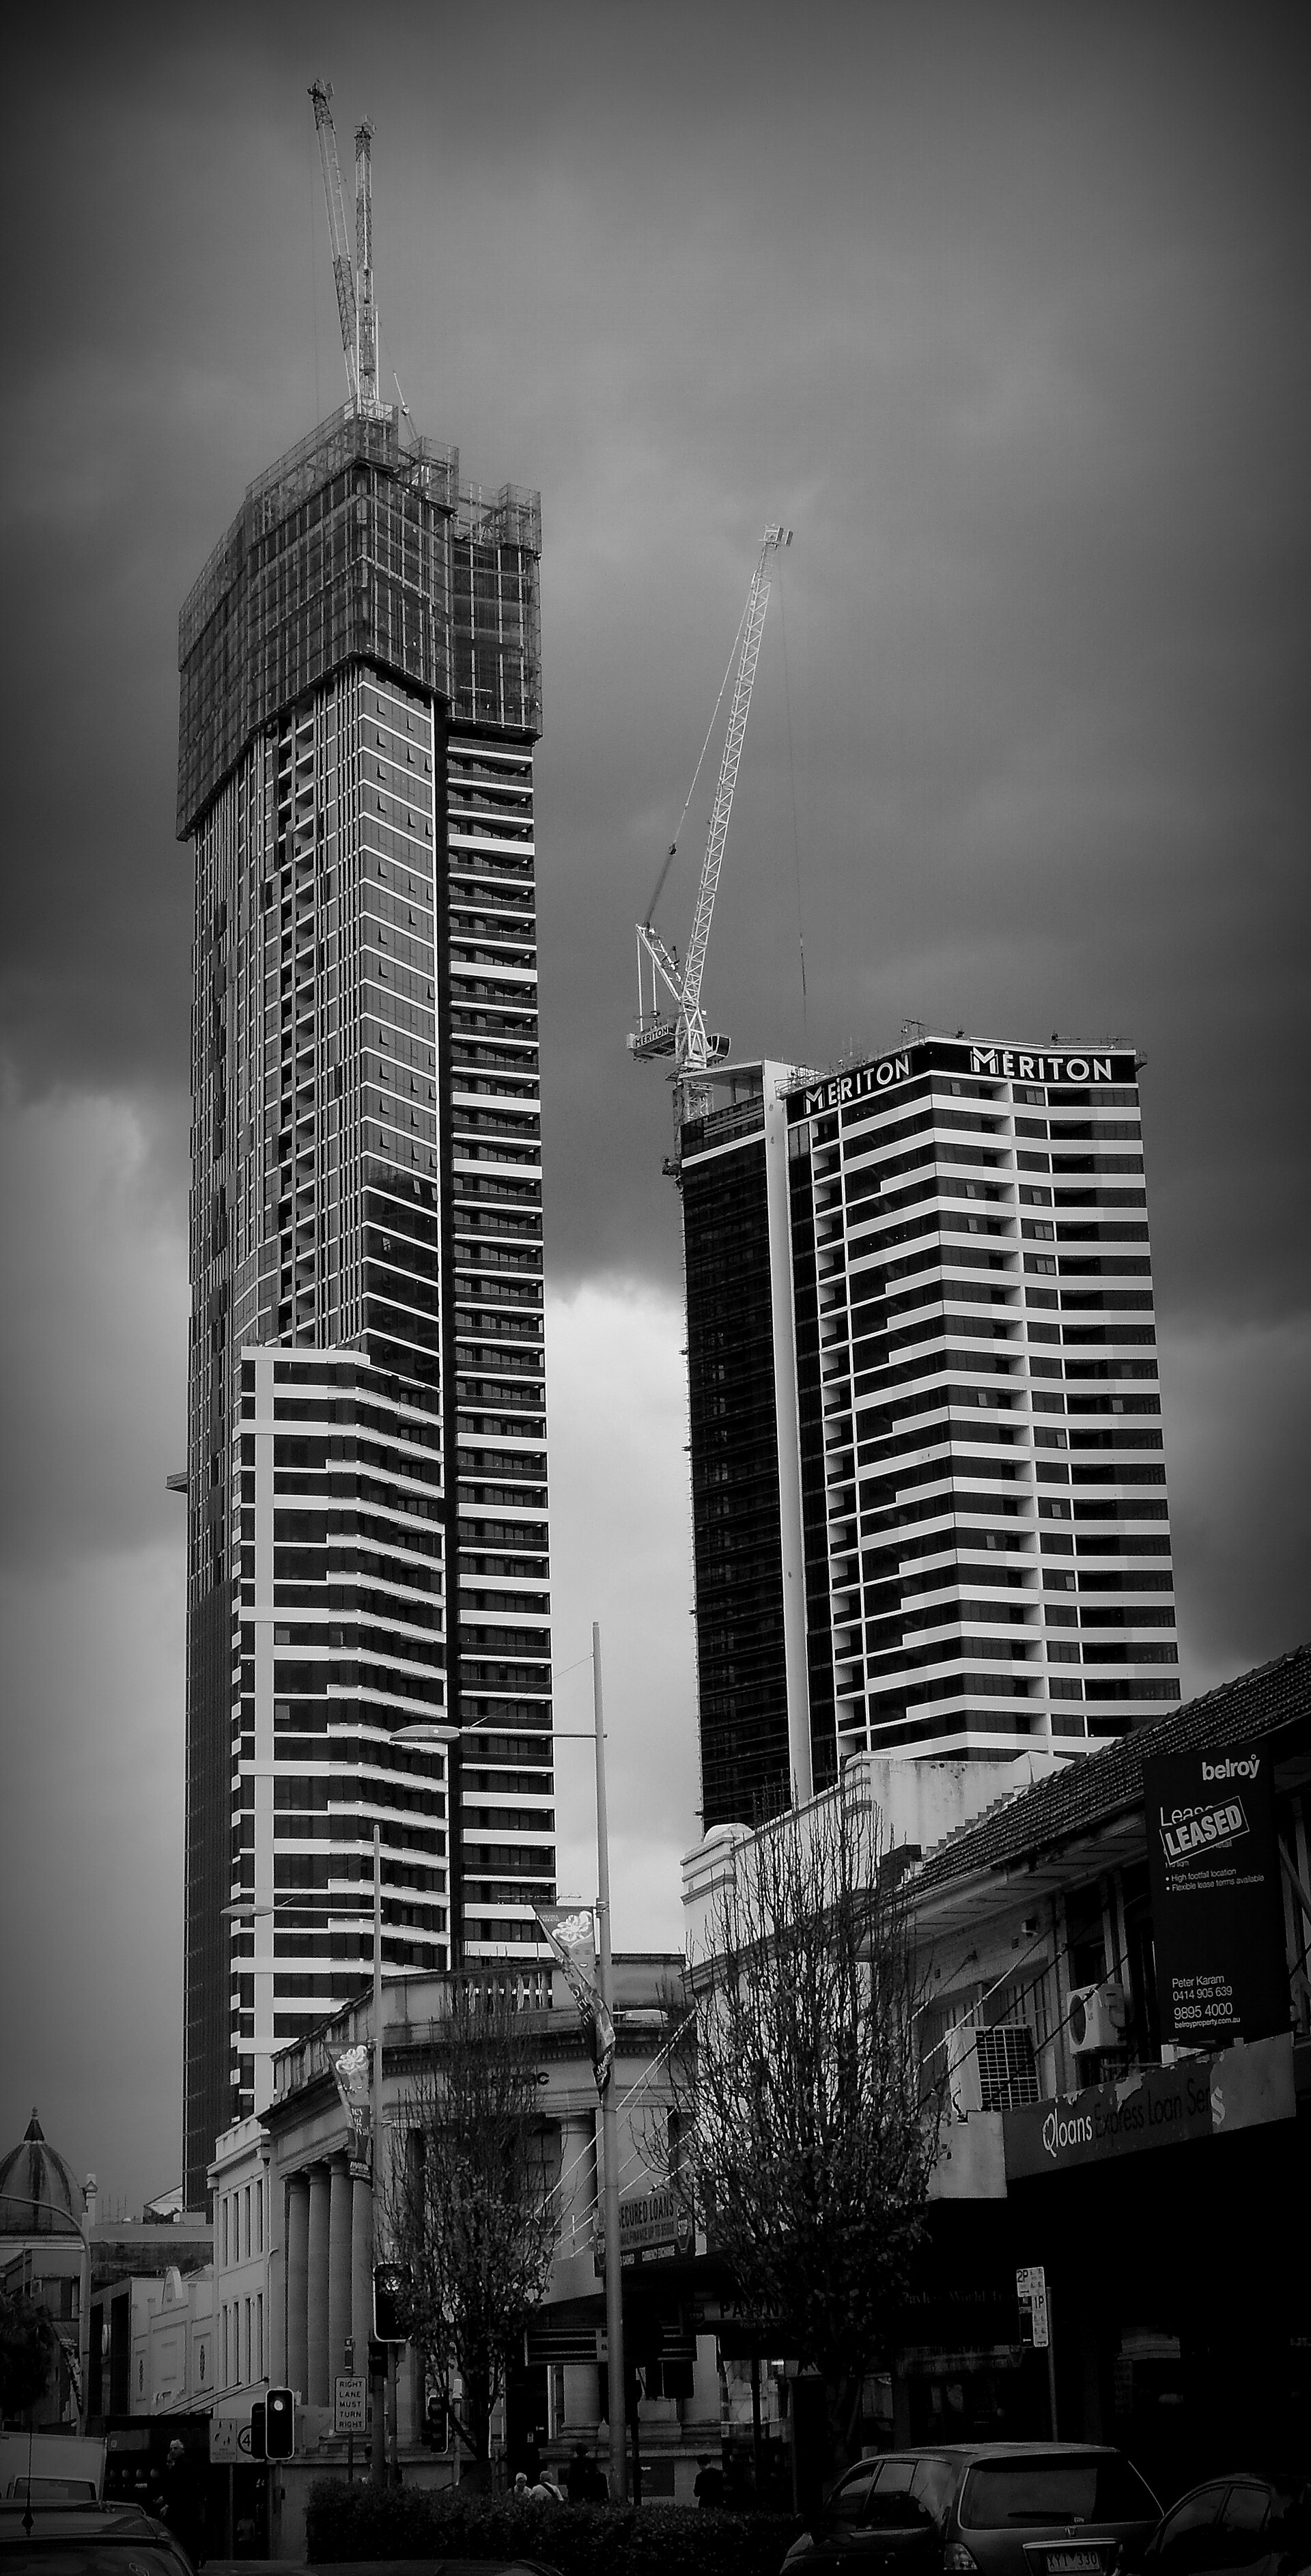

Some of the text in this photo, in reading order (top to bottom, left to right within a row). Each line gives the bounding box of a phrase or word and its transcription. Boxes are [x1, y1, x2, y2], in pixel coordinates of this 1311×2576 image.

[635, 1026, 668, 1047] MERITON
[970, 1046, 1112, 1081] MERITON
[804, 1054, 911, 1115] MERITON
[1202, 1754, 1260, 1780] belroy
[1160, 1805, 1213, 1827] Lea
[1165, 1804, 1243, 1856] LEASED
[1171, 1868, 1237, 1884] High footfall location
[1172, 1875, 1265, 1892] Flexible lease terms available
[1172, 1975, 1225, 1988] Peter Karam
[1173, 1986, 1232, 2001] 0414 905 639
[1174, 2002, 1233, 2020] 9895 4000
[1174, 2017, 1241, 2028] belroyproperty.com.au
[1042, 2108, 1093, 2157] Qloans
[1148, 2090, 1182, 2126] Loan
[619, 2200, 648, 2230] ECURED
[649, 2193, 675, 2222] LOANS
[1017, 2269, 1028, 2283] 2P
[1034, 2295, 1044, 2309] 1P
